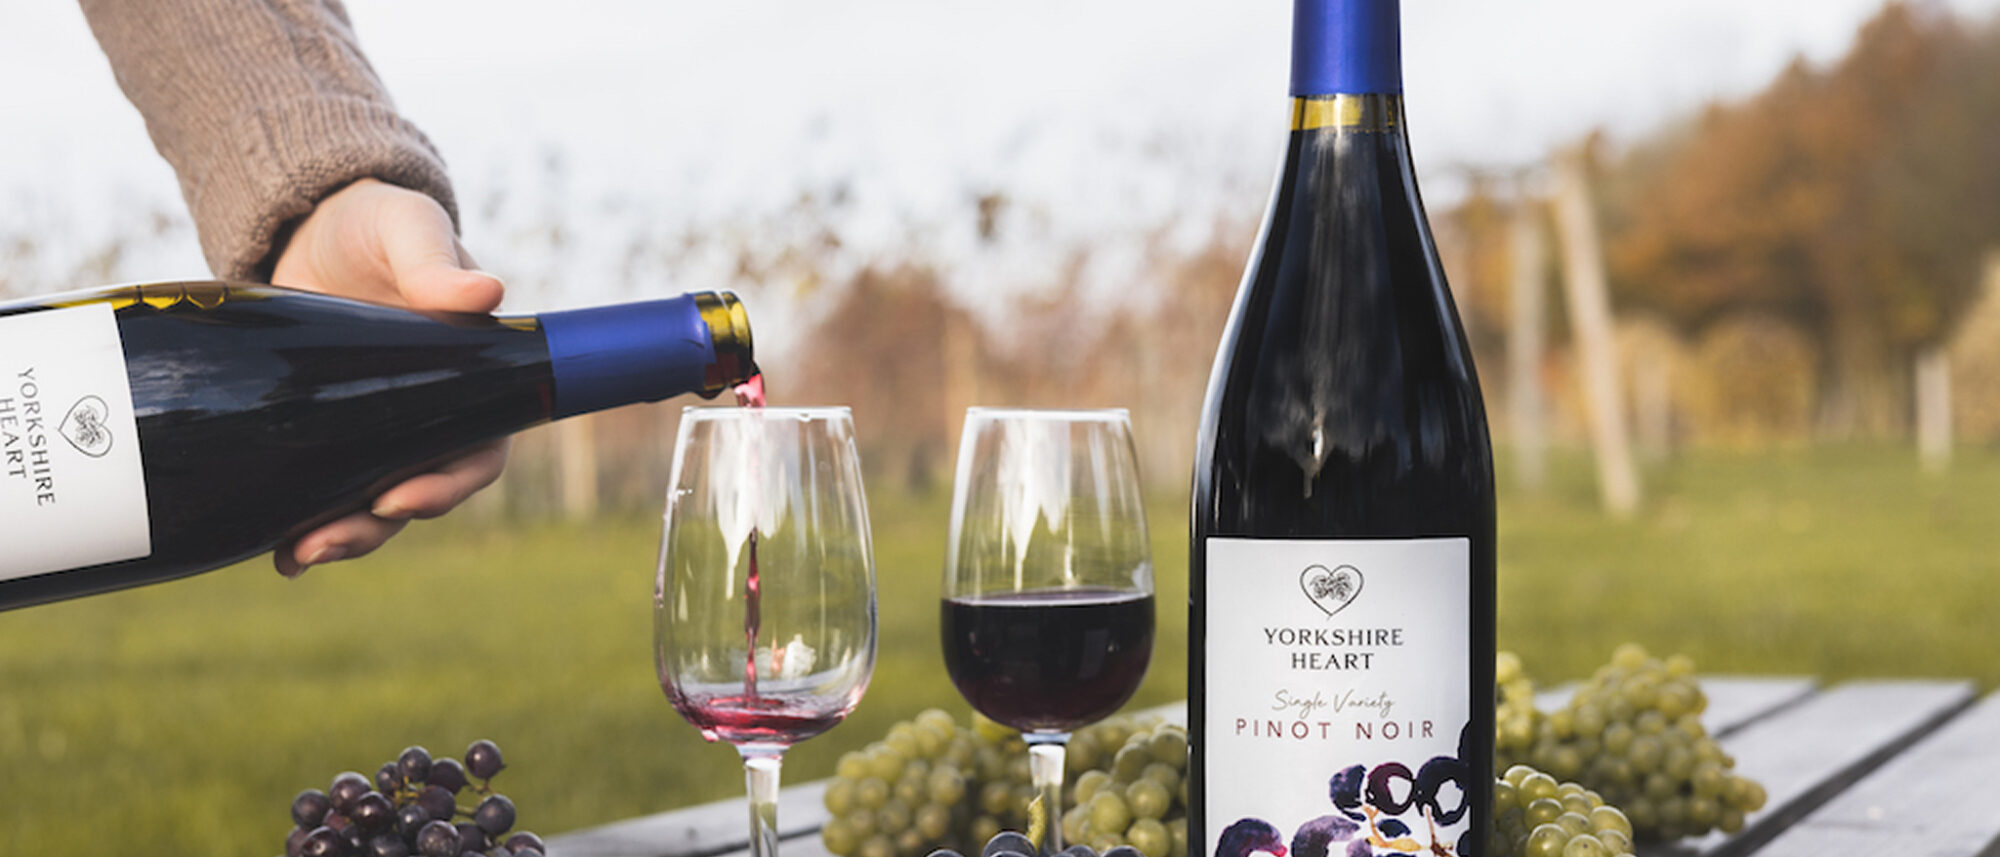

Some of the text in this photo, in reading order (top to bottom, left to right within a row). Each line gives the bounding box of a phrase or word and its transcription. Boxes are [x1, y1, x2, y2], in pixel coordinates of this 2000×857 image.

[0, 398, 27, 478] HEART
[18, 367, 55, 506] YORKSHIRE
[1264, 627, 1404, 646] YORKSHIRE
[1291, 653, 1375, 670] HEART
[1272, 689, 1396, 719] Single Variety
[1235, 718, 1434, 740] PINOT NOIR
